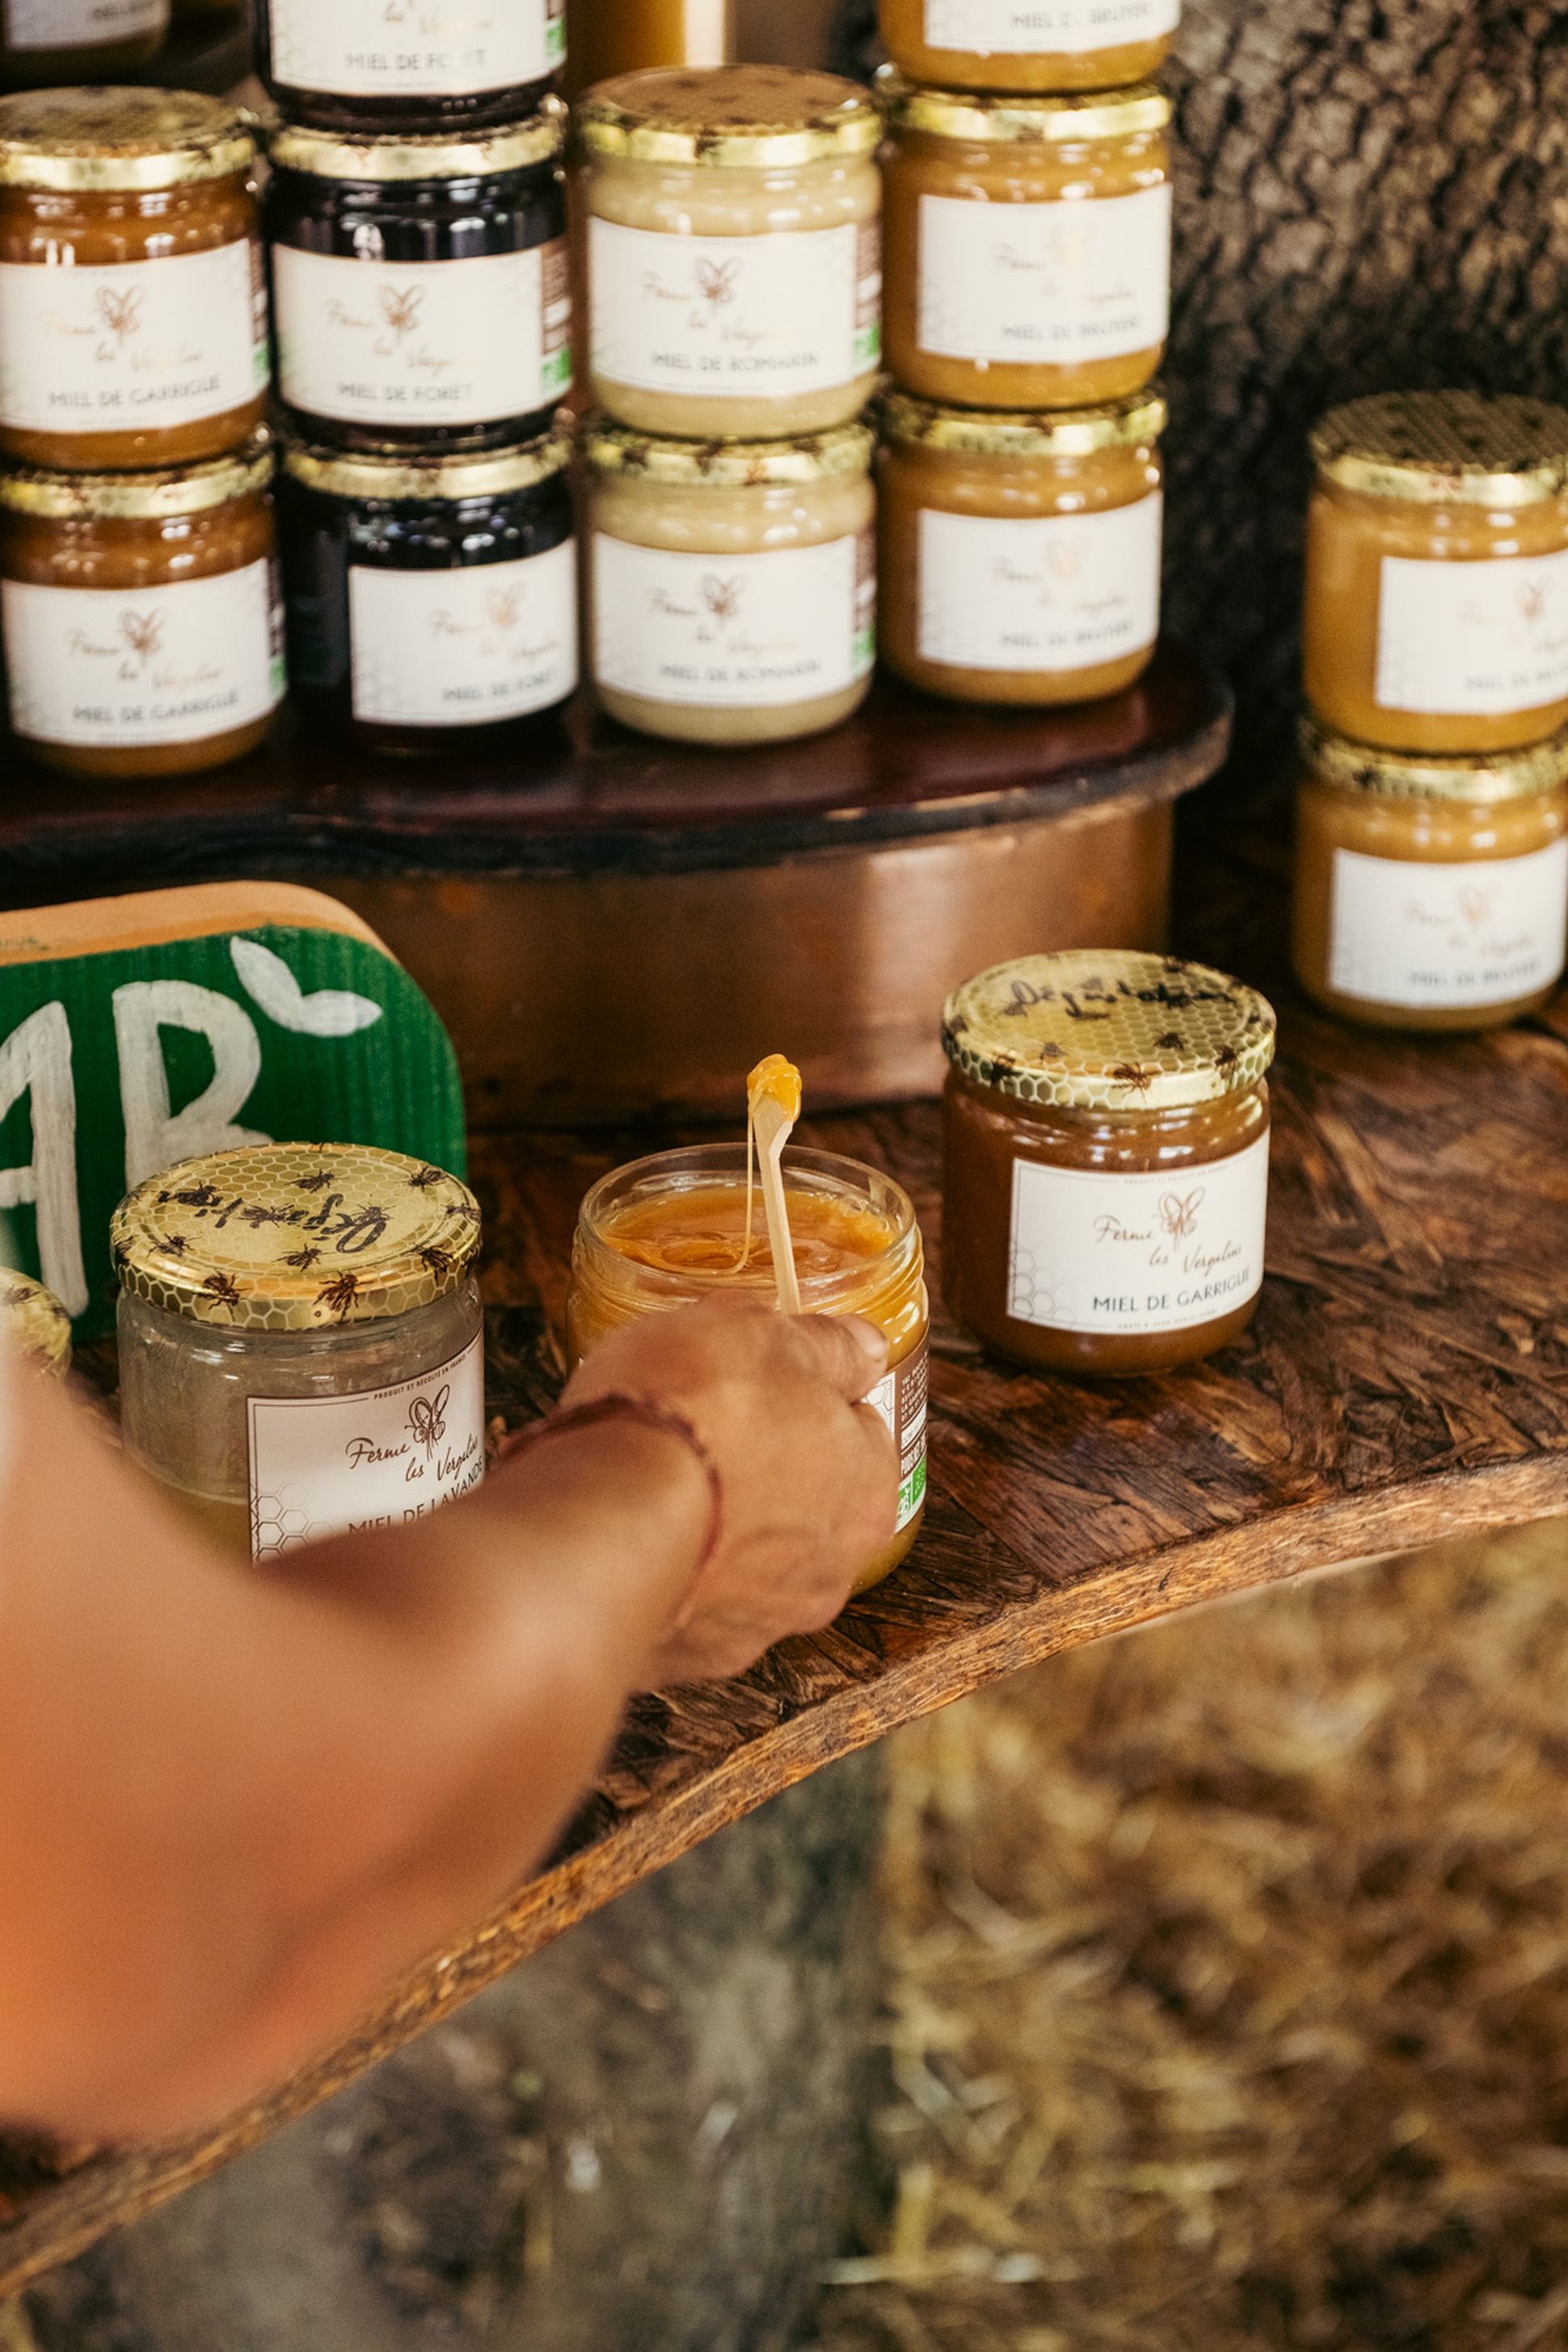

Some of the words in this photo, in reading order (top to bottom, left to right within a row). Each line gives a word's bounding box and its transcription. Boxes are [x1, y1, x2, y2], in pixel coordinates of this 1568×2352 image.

[1094, 1215, 1156, 1244] Ferme
[1149, 1245, 1170, 1266] les
[1093, 1296, 1139, 1313] MIEL
[1146, 1294, 1171, 1311] DE
[1176, 1265, 1251, 1307] GARRIGUE
[373, 1386, 405, 1401] PRODUIT
[407, 1383, 415, 1391] ET
[345, 1437, 411, 1470] Ferme
[405, 1456, 425, 1482] les
[403, 1503, 425, 1525] DE
